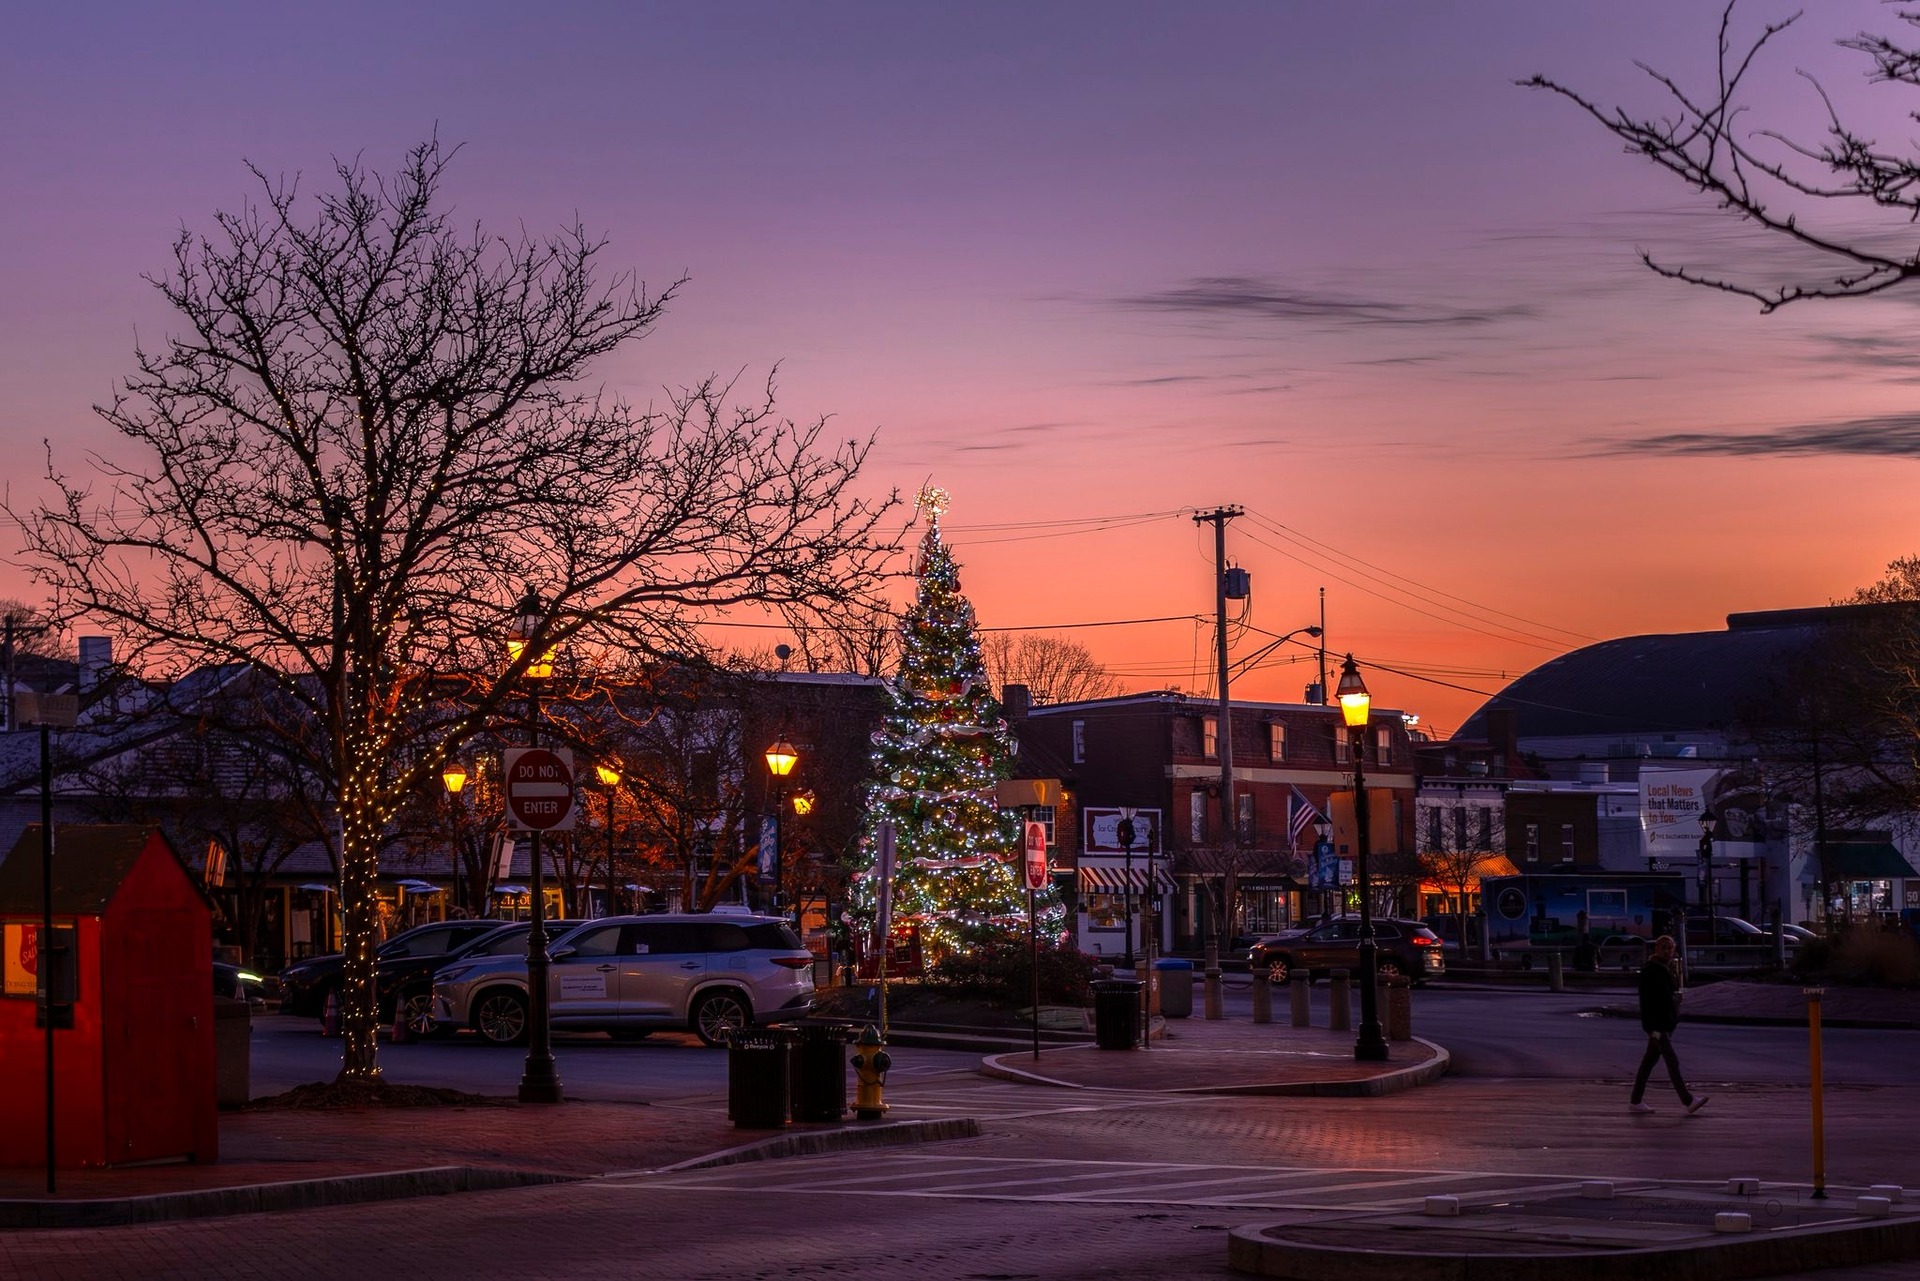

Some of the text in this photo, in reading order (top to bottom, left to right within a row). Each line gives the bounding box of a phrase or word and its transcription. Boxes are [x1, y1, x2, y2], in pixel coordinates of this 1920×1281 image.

[519, 765, 534, 778] DO
[1647, 784, 1694, 797] Local News
[523, 801, 558, 814] ENTER
[1648, 797, 1699, 811] that Matters
[1648, 811, 1677, 823] to You.
[1906, 891, 1918, 902] 50
